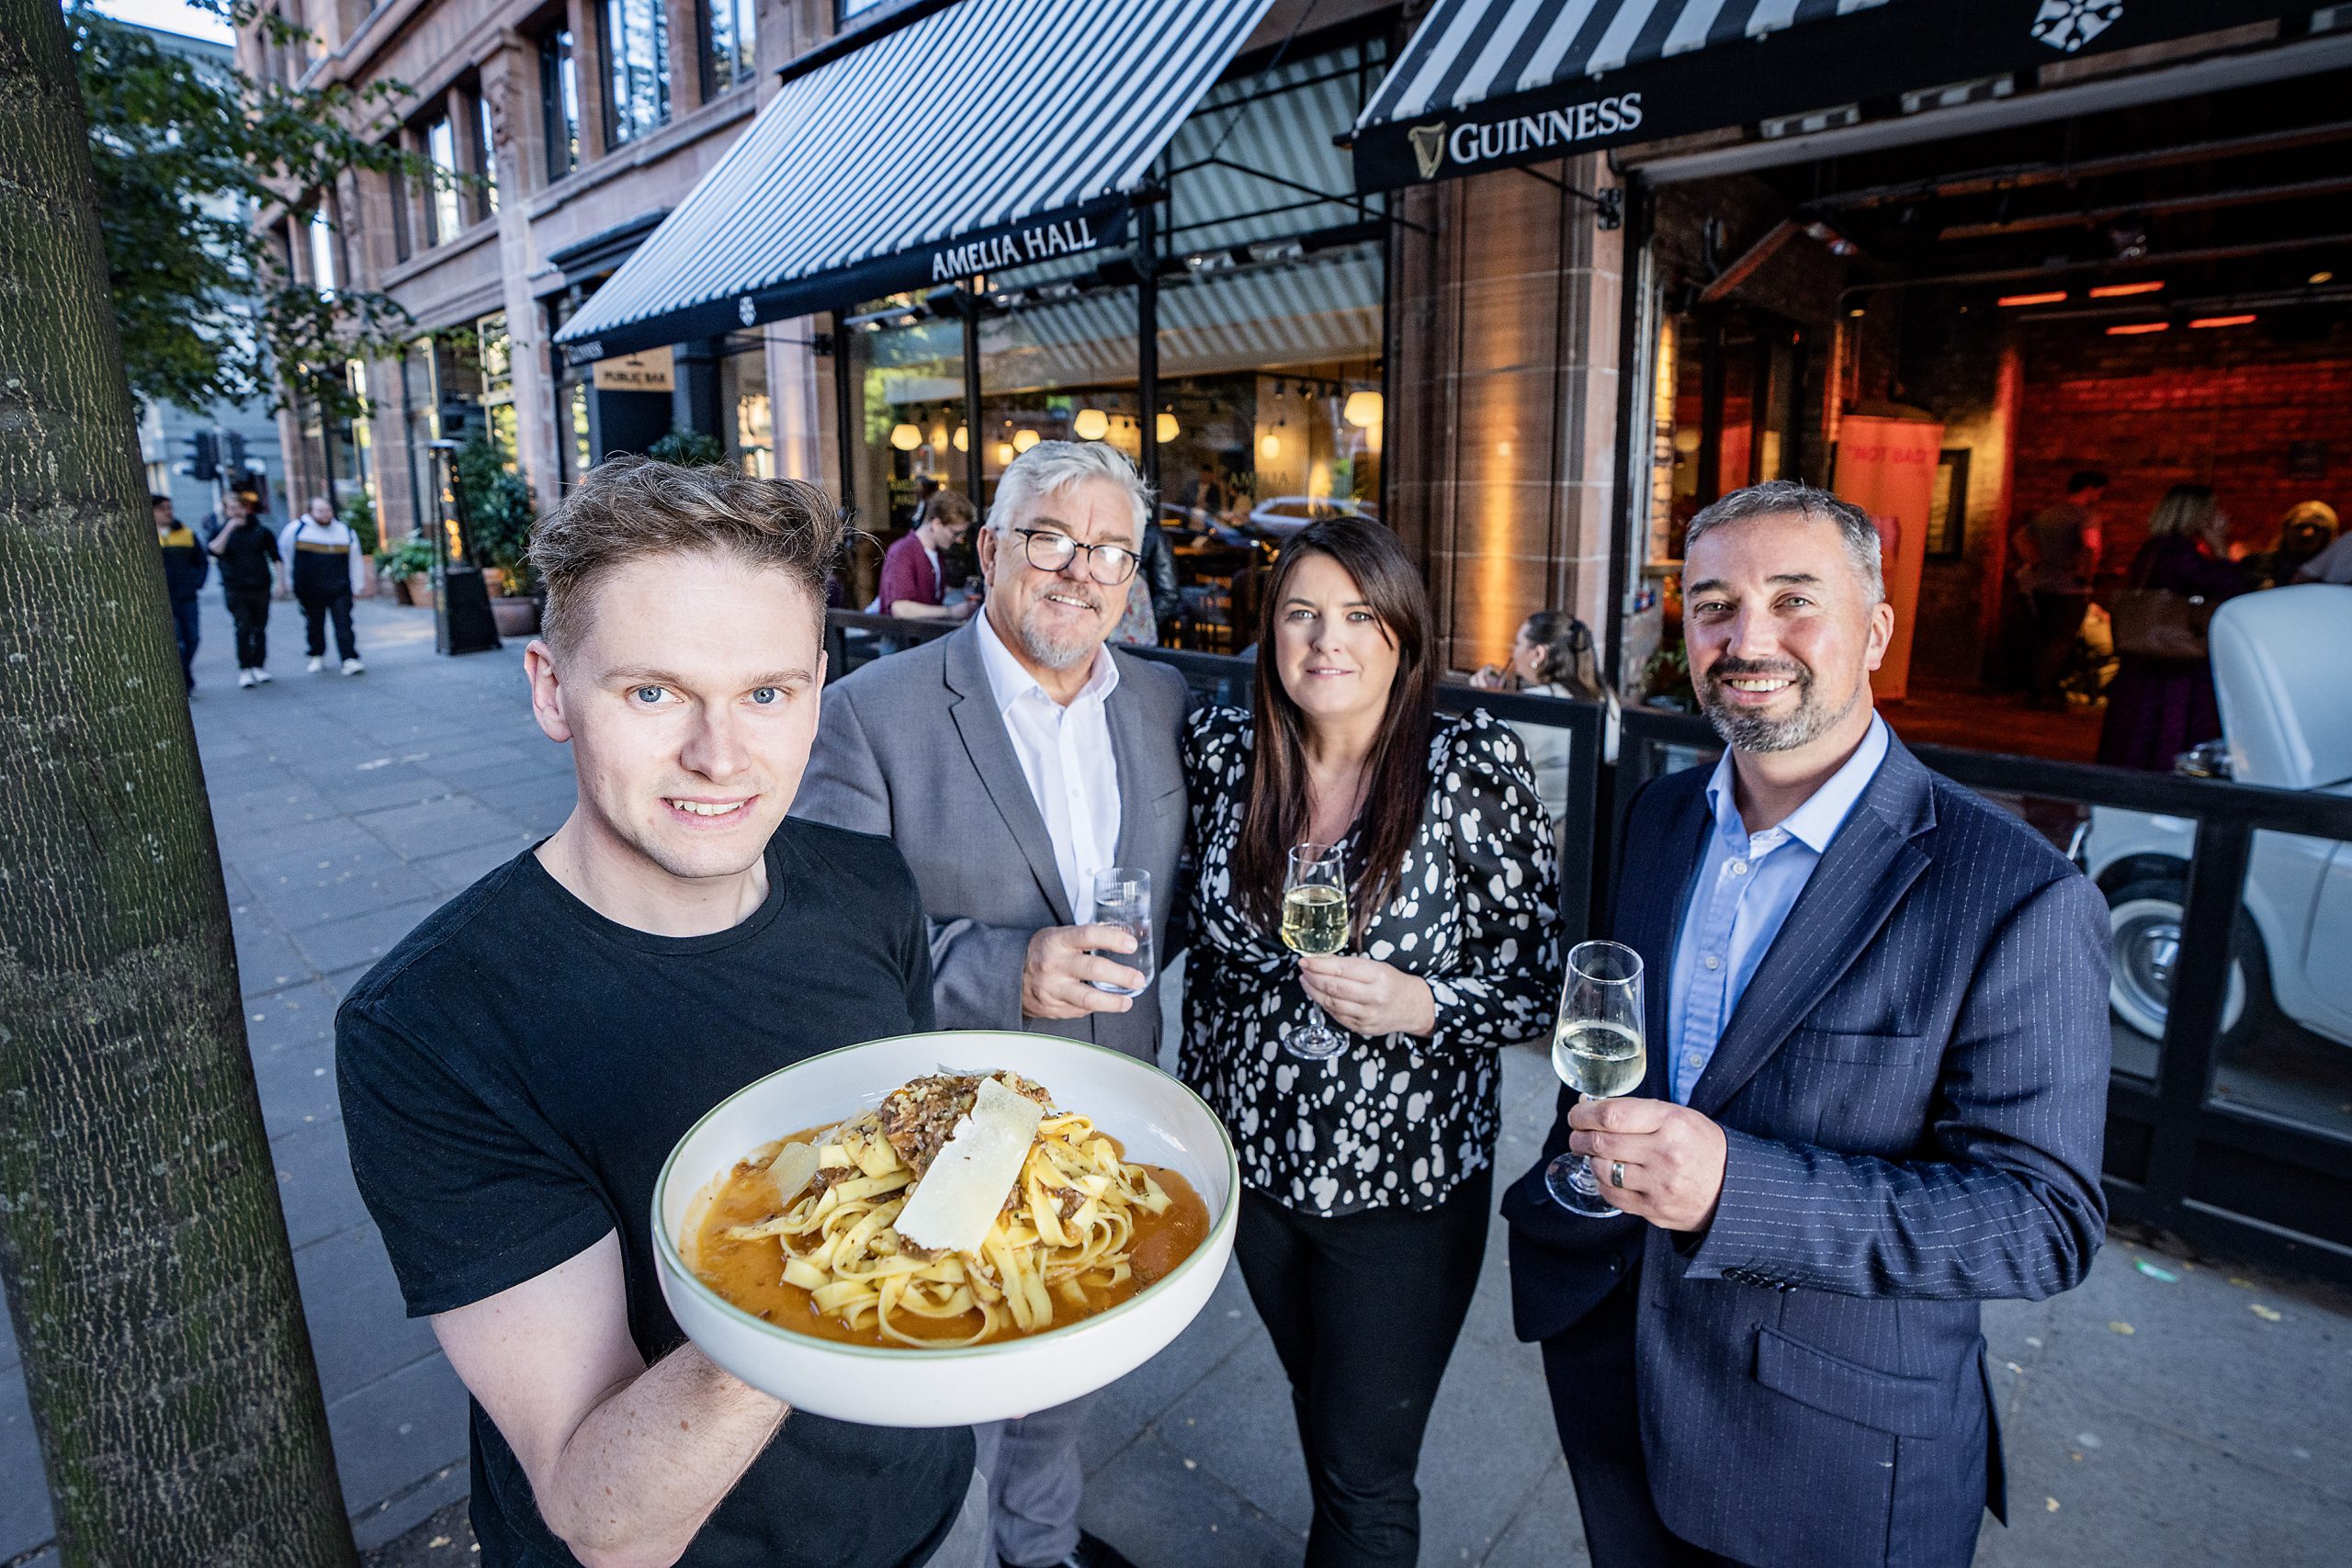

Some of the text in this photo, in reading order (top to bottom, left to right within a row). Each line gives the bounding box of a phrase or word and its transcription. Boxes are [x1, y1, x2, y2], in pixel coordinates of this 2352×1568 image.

[1449, 92, 1643, 164] GUINNESS
[932, 217, 1098, 282] AMELIA HALL
[604, 370, 666, 383] PUBLIC BAR
